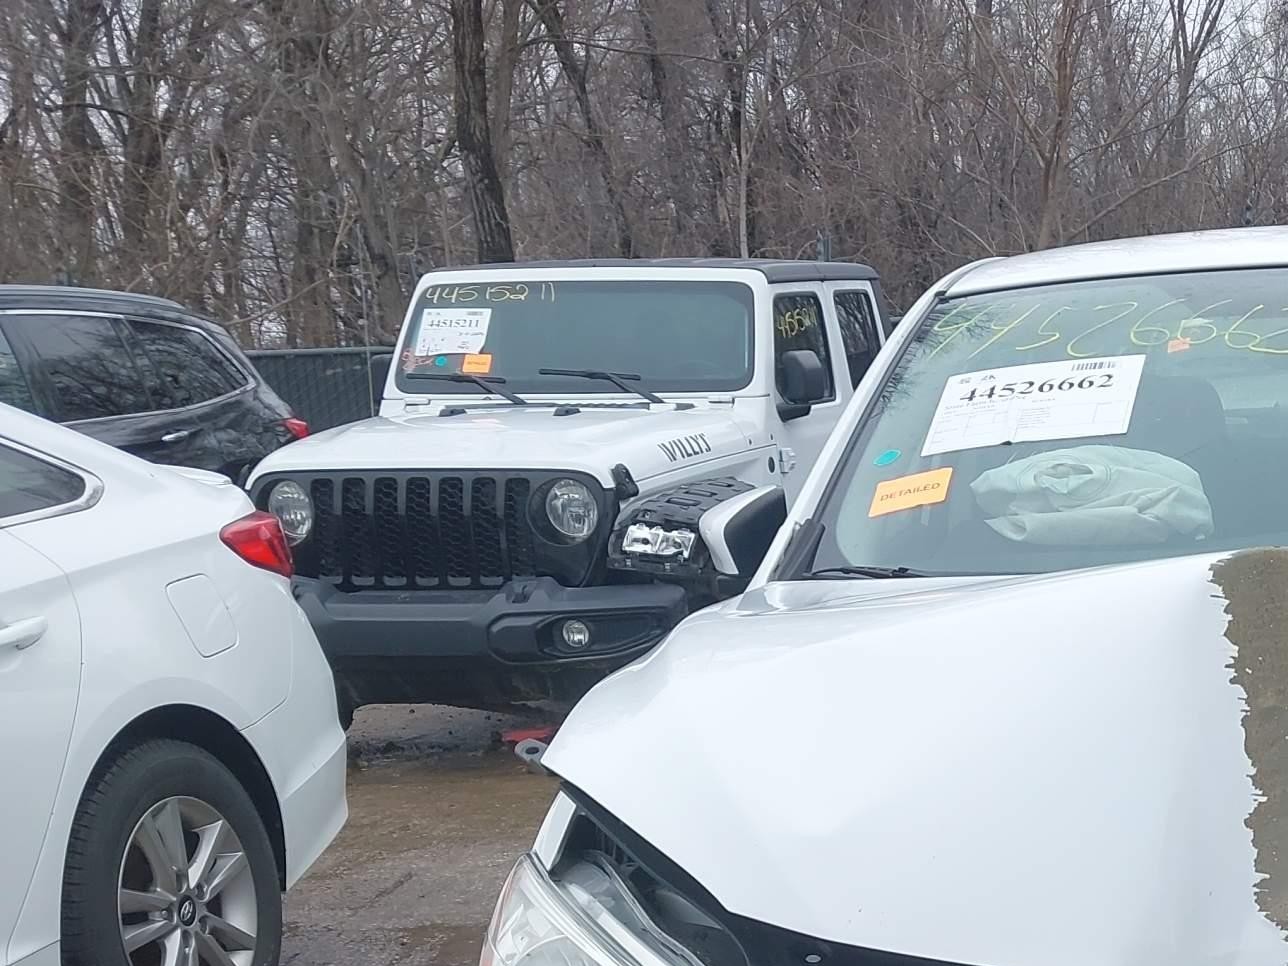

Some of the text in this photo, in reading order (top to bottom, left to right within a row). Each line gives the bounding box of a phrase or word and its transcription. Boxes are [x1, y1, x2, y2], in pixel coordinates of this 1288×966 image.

[427, 318, 481, 329] 44515211
[959, 373, 1115, 402] 44526662
[657, 432, 712, 463] WILLYS
[880, 482, 941, 502] DETAILED
